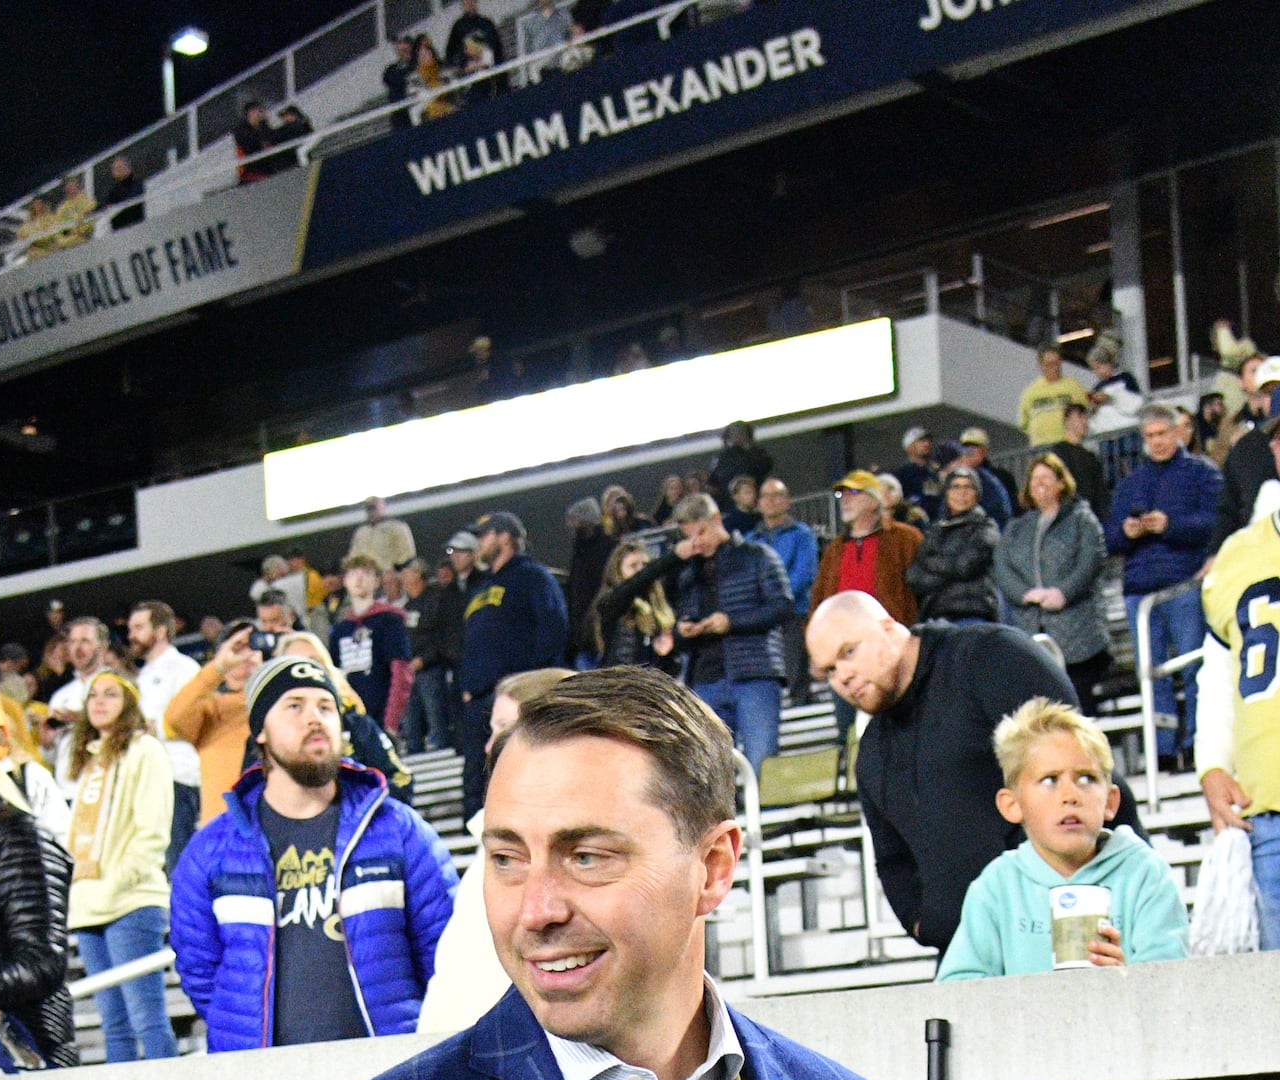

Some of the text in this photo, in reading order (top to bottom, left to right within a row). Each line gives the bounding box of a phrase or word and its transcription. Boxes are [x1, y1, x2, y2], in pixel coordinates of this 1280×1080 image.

[408, 27, 827, 196] WILLIAM ALEXANDER
[67, 260, 131, 318] HALL
[128, 247, 163, 298] OF
[164, 220, 240, 286] FAME
